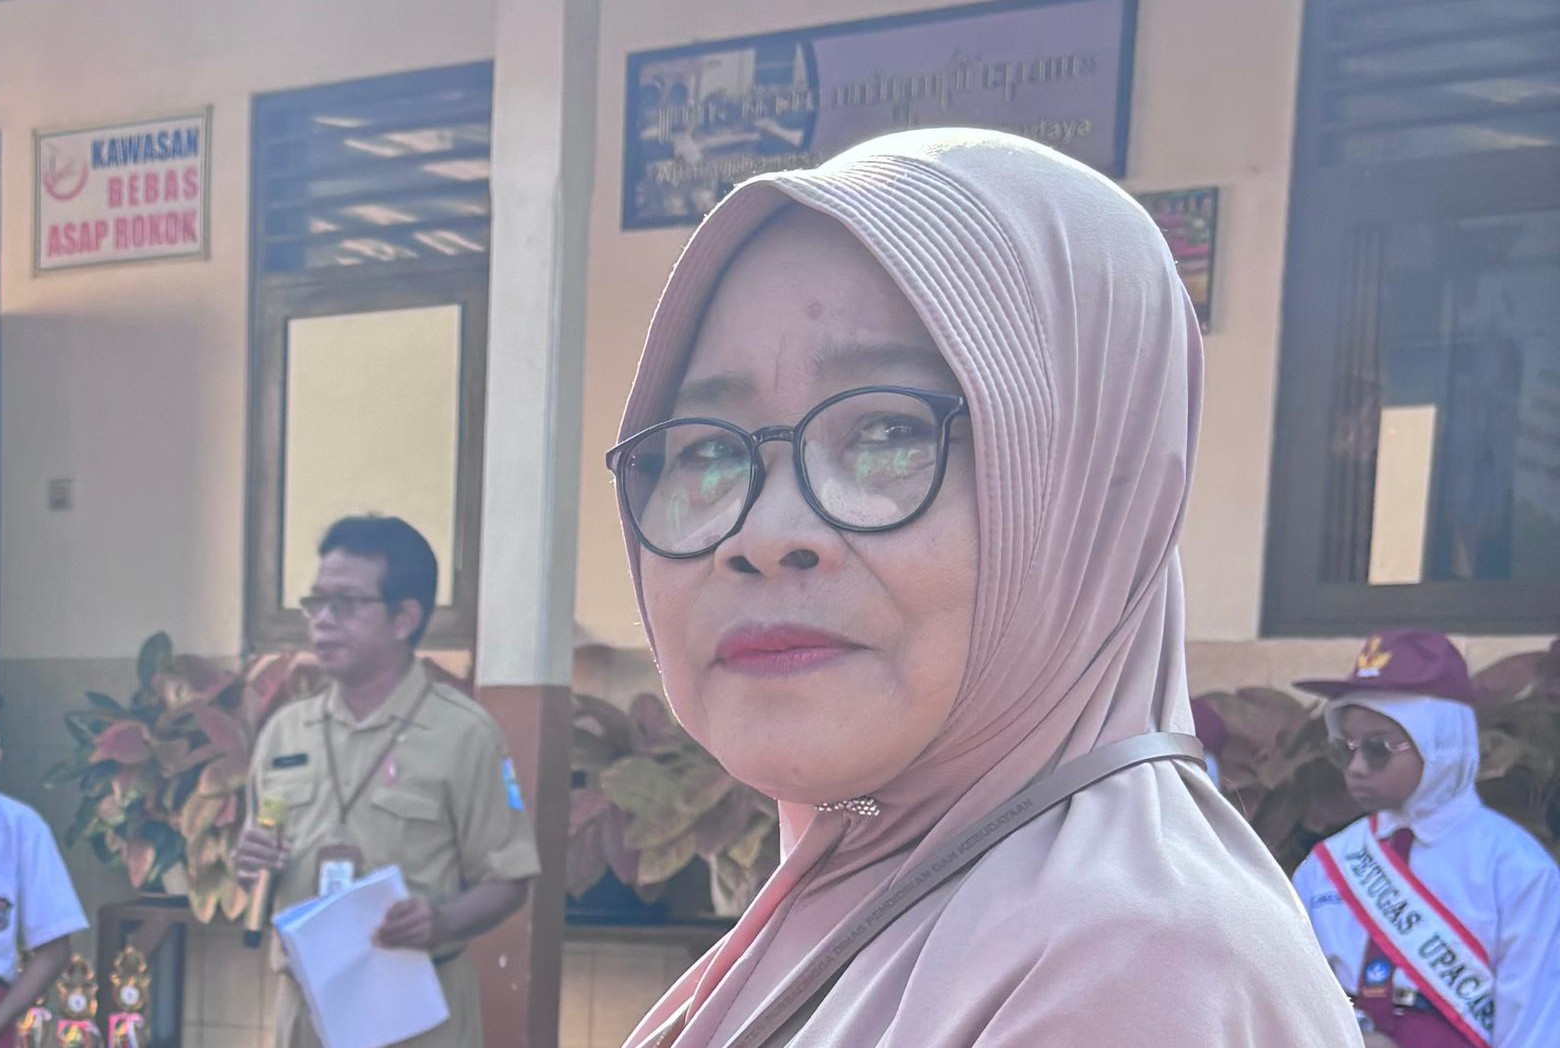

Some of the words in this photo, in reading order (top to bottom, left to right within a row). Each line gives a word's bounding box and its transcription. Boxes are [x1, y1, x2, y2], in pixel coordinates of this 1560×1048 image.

[92, 127, 200, 171] KAWASAN
[107, 166, 199, 208] BEBAS
[47, 219, 109, 258] ASAP
[114, 209, 198, 250] ROKOK
[1345, 845, 1423, 936] PETUGAS
[1418, 931, 1496, 1031] UPACAR
